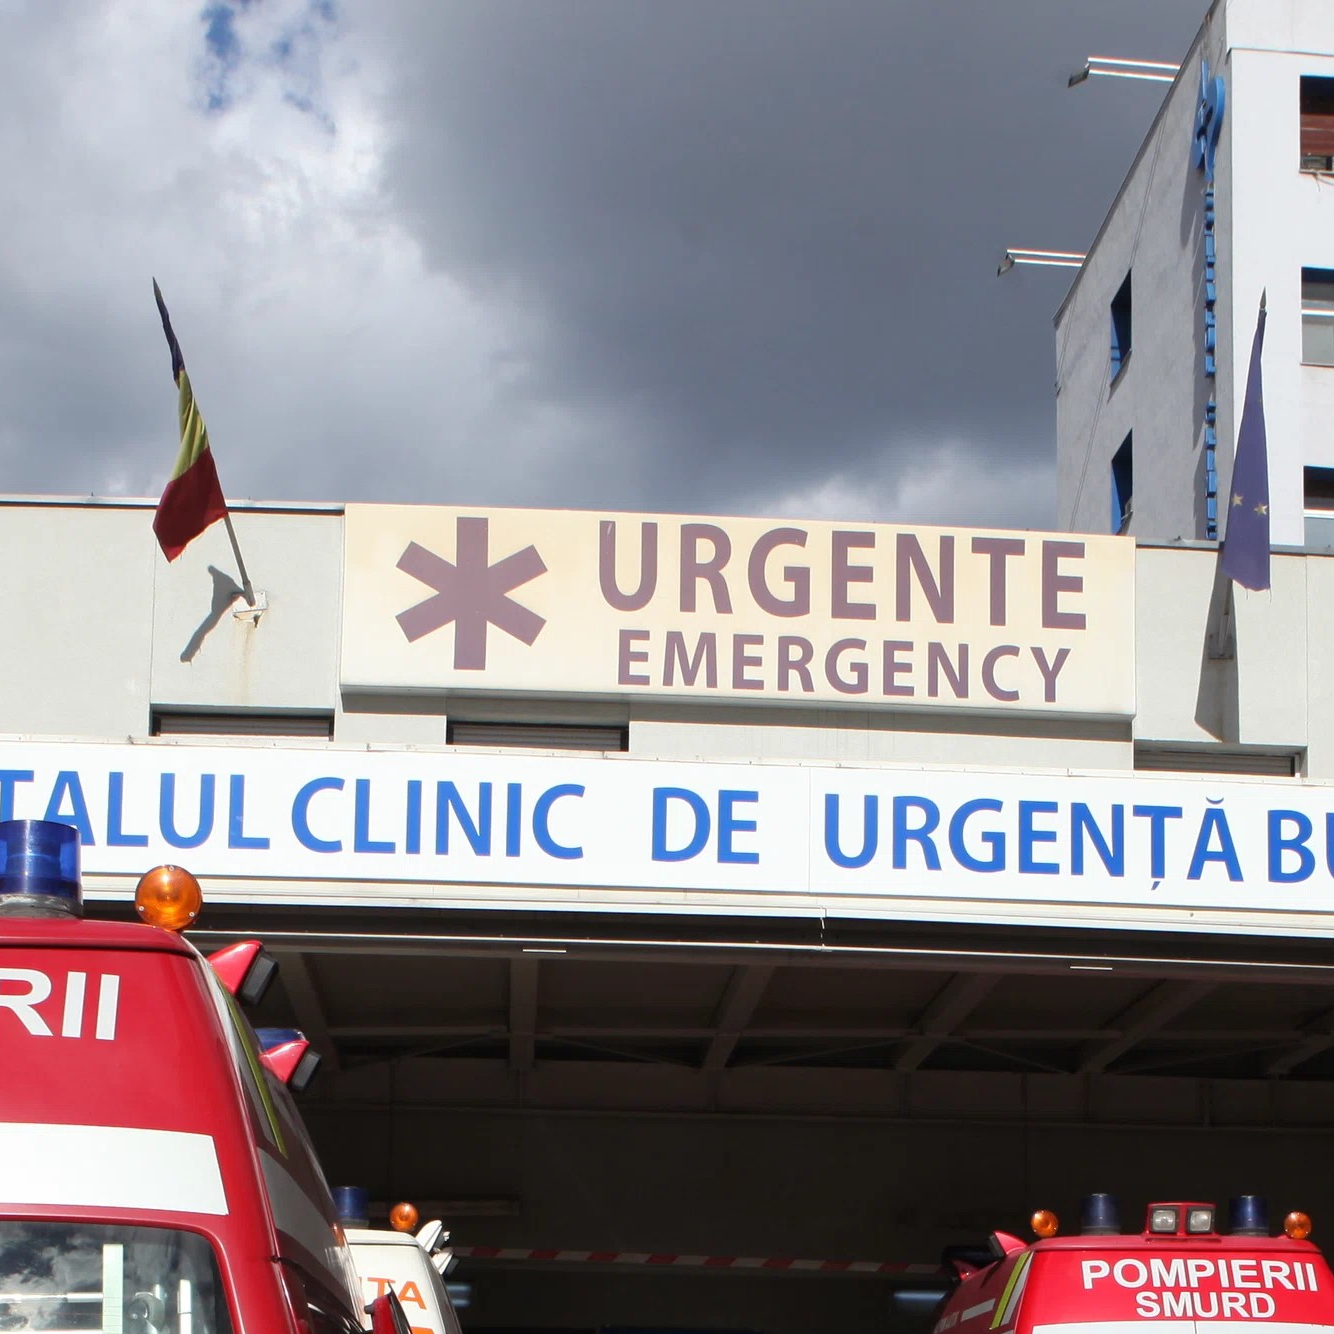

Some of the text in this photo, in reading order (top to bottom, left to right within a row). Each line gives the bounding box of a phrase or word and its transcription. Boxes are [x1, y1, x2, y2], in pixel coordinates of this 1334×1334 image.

[599, 520, 1087, 630] URGENTE
[618, 629, 1071, 702] EMERGENCY
[291, 777, 584, 860] CLINIC
[653, 786, 759, 865] DE
[823, 793, 1243, 891] URGENȚĂ
[1081, 1258, 1319, 1292] POMPIERII
[1136, 1291, 1276, 1319] SMURD
